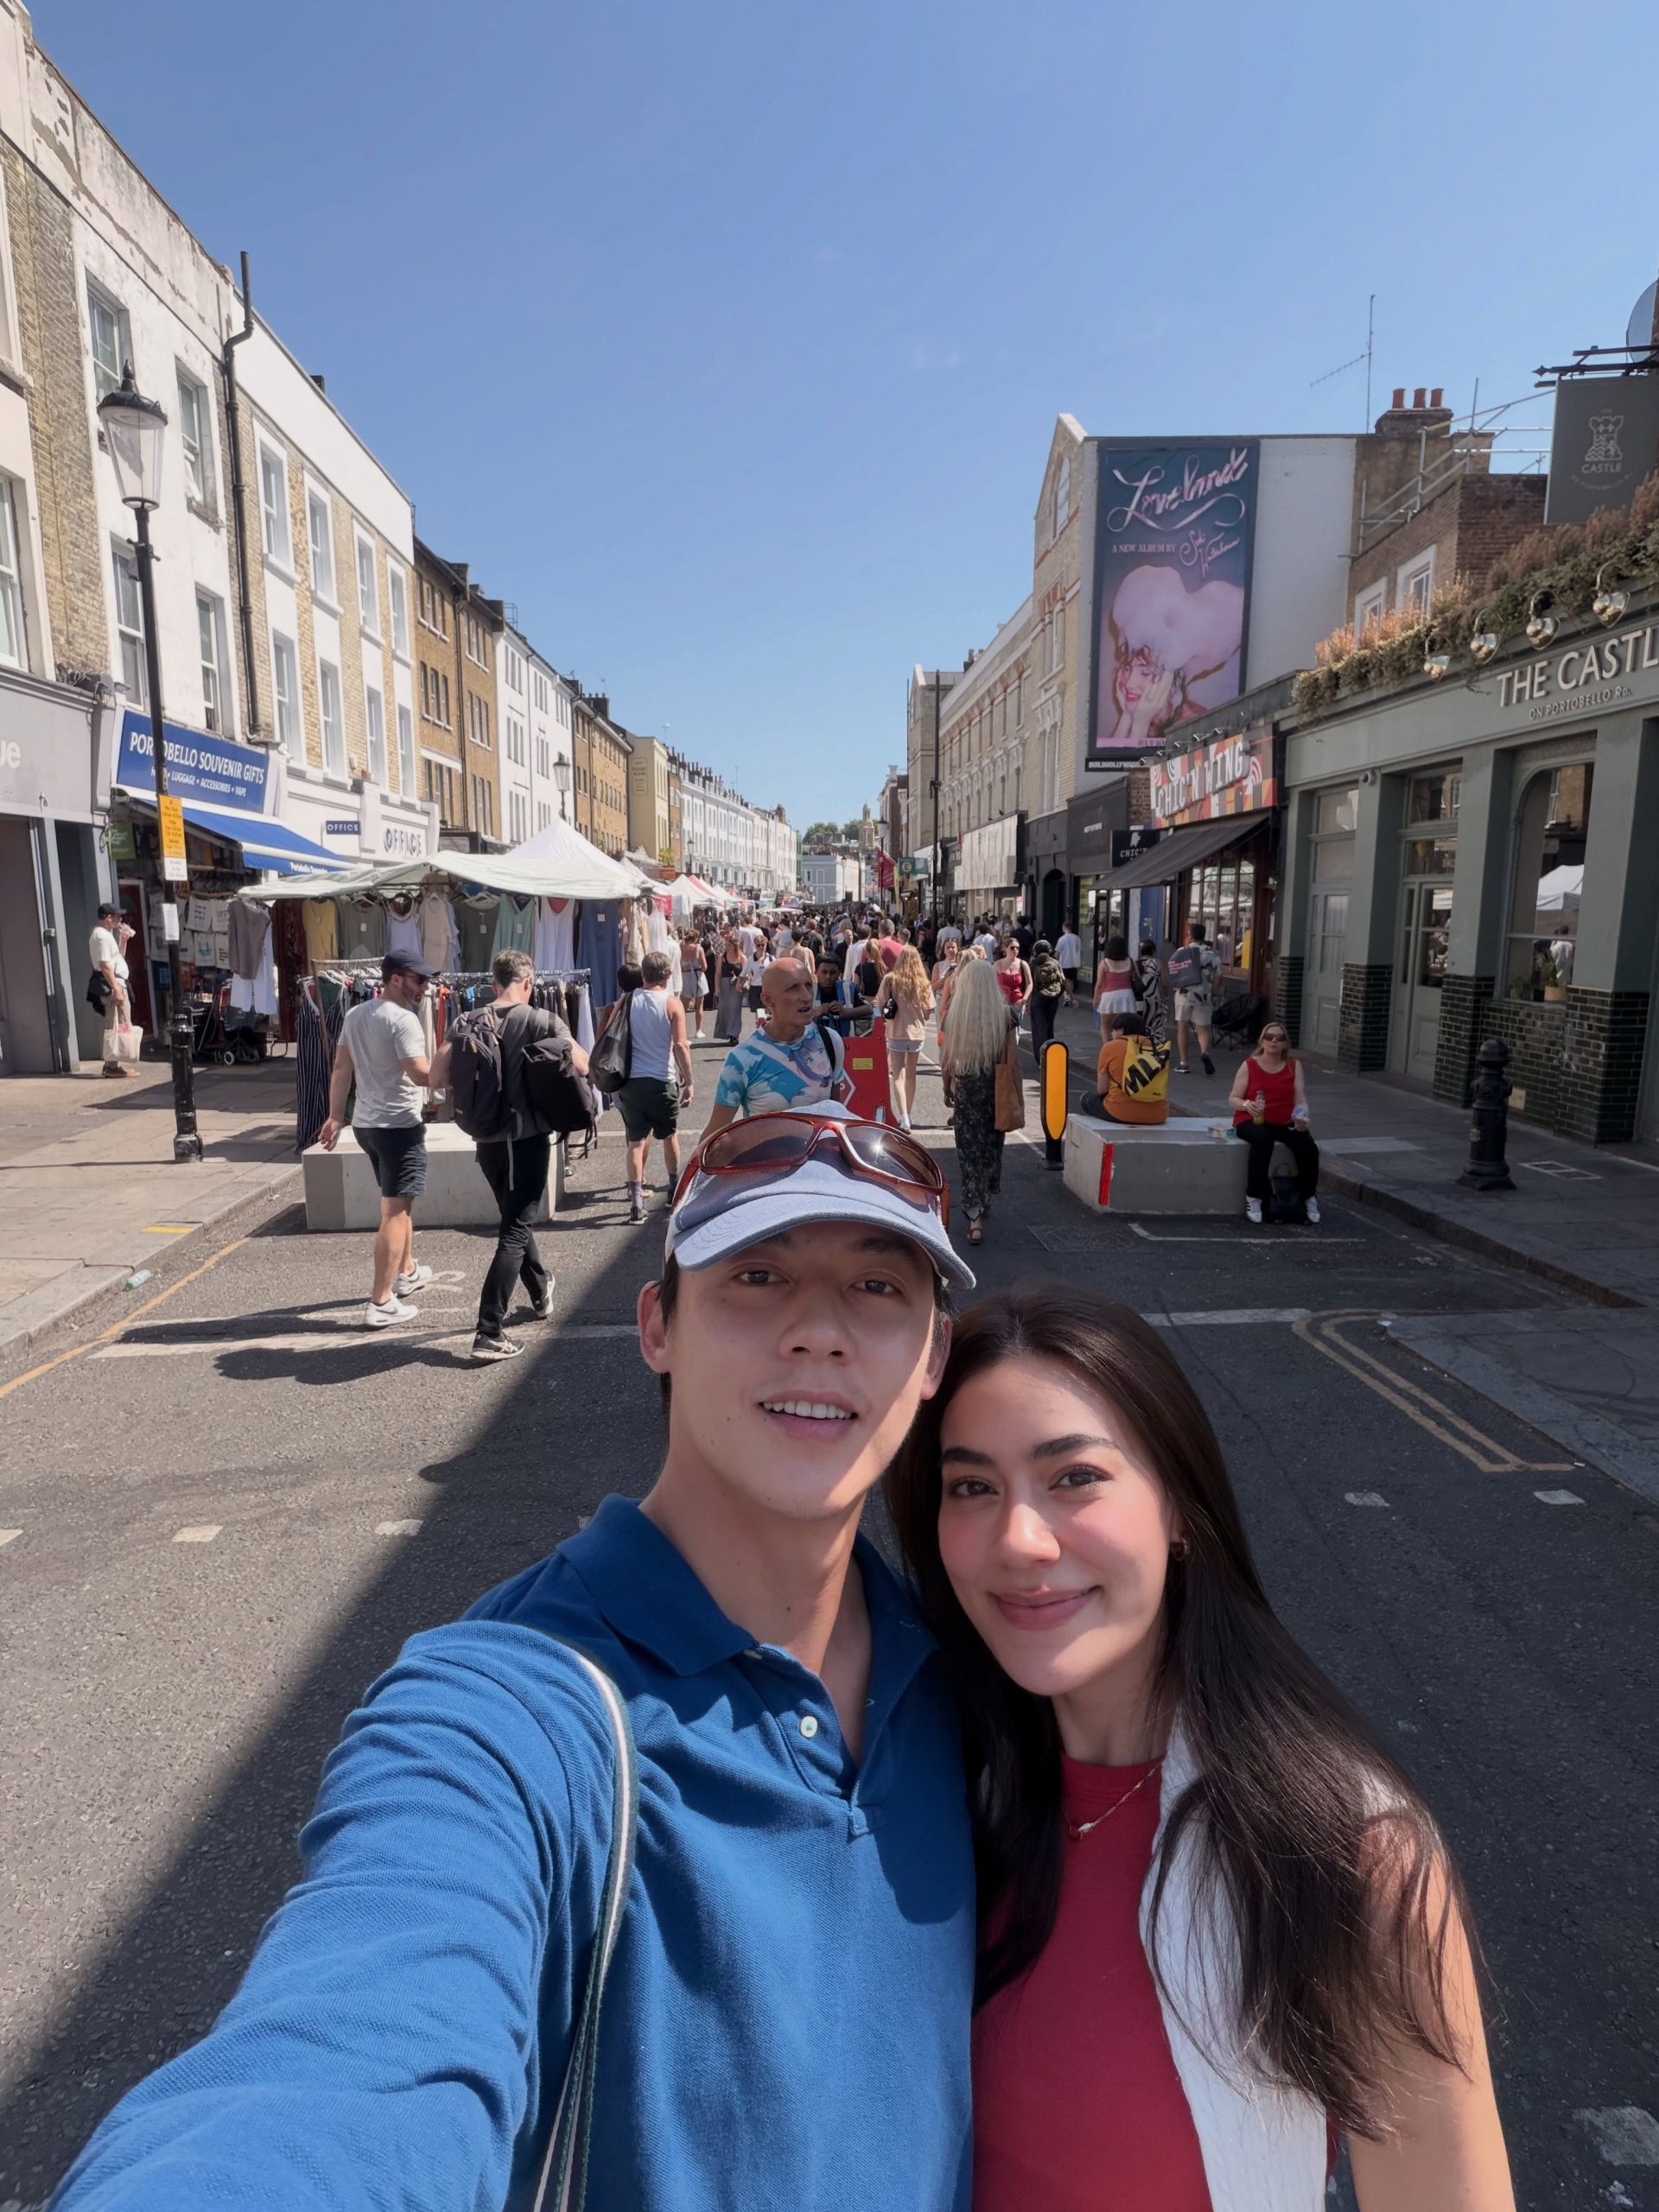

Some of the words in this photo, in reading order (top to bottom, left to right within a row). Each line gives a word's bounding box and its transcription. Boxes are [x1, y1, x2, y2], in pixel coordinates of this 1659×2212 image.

[1582, 462, 1622, 474] CASTLE
[1118, 544, 1135, 553] NEW
[1137, 544, 1164, 553] ALBUM
[1497, 660, 1548, 707] THE
[1557, 627, 1659, 690] CASTL
[1529, 708, 1543, 720] ON
[1546, 689, 1611, 715] PORTOBELLO
[130, 732, 198, 769] POROBELLO
[199, 753, 243, 779] SOUVENIR
[243, 764, 264, 784] GIFTS
[171, 771, 196, 785] LUGGAGE
[200, 778, 231, 793] ACCESSORIES
[235, 786, 246, 797] VAPE
[1155, 768, 1199, 817] CHIC'N
[1204, 741, 1243, 794] WING
[327, 823, 359, 832] OFFICE
[385, 828, 422, 855] OFFICE
